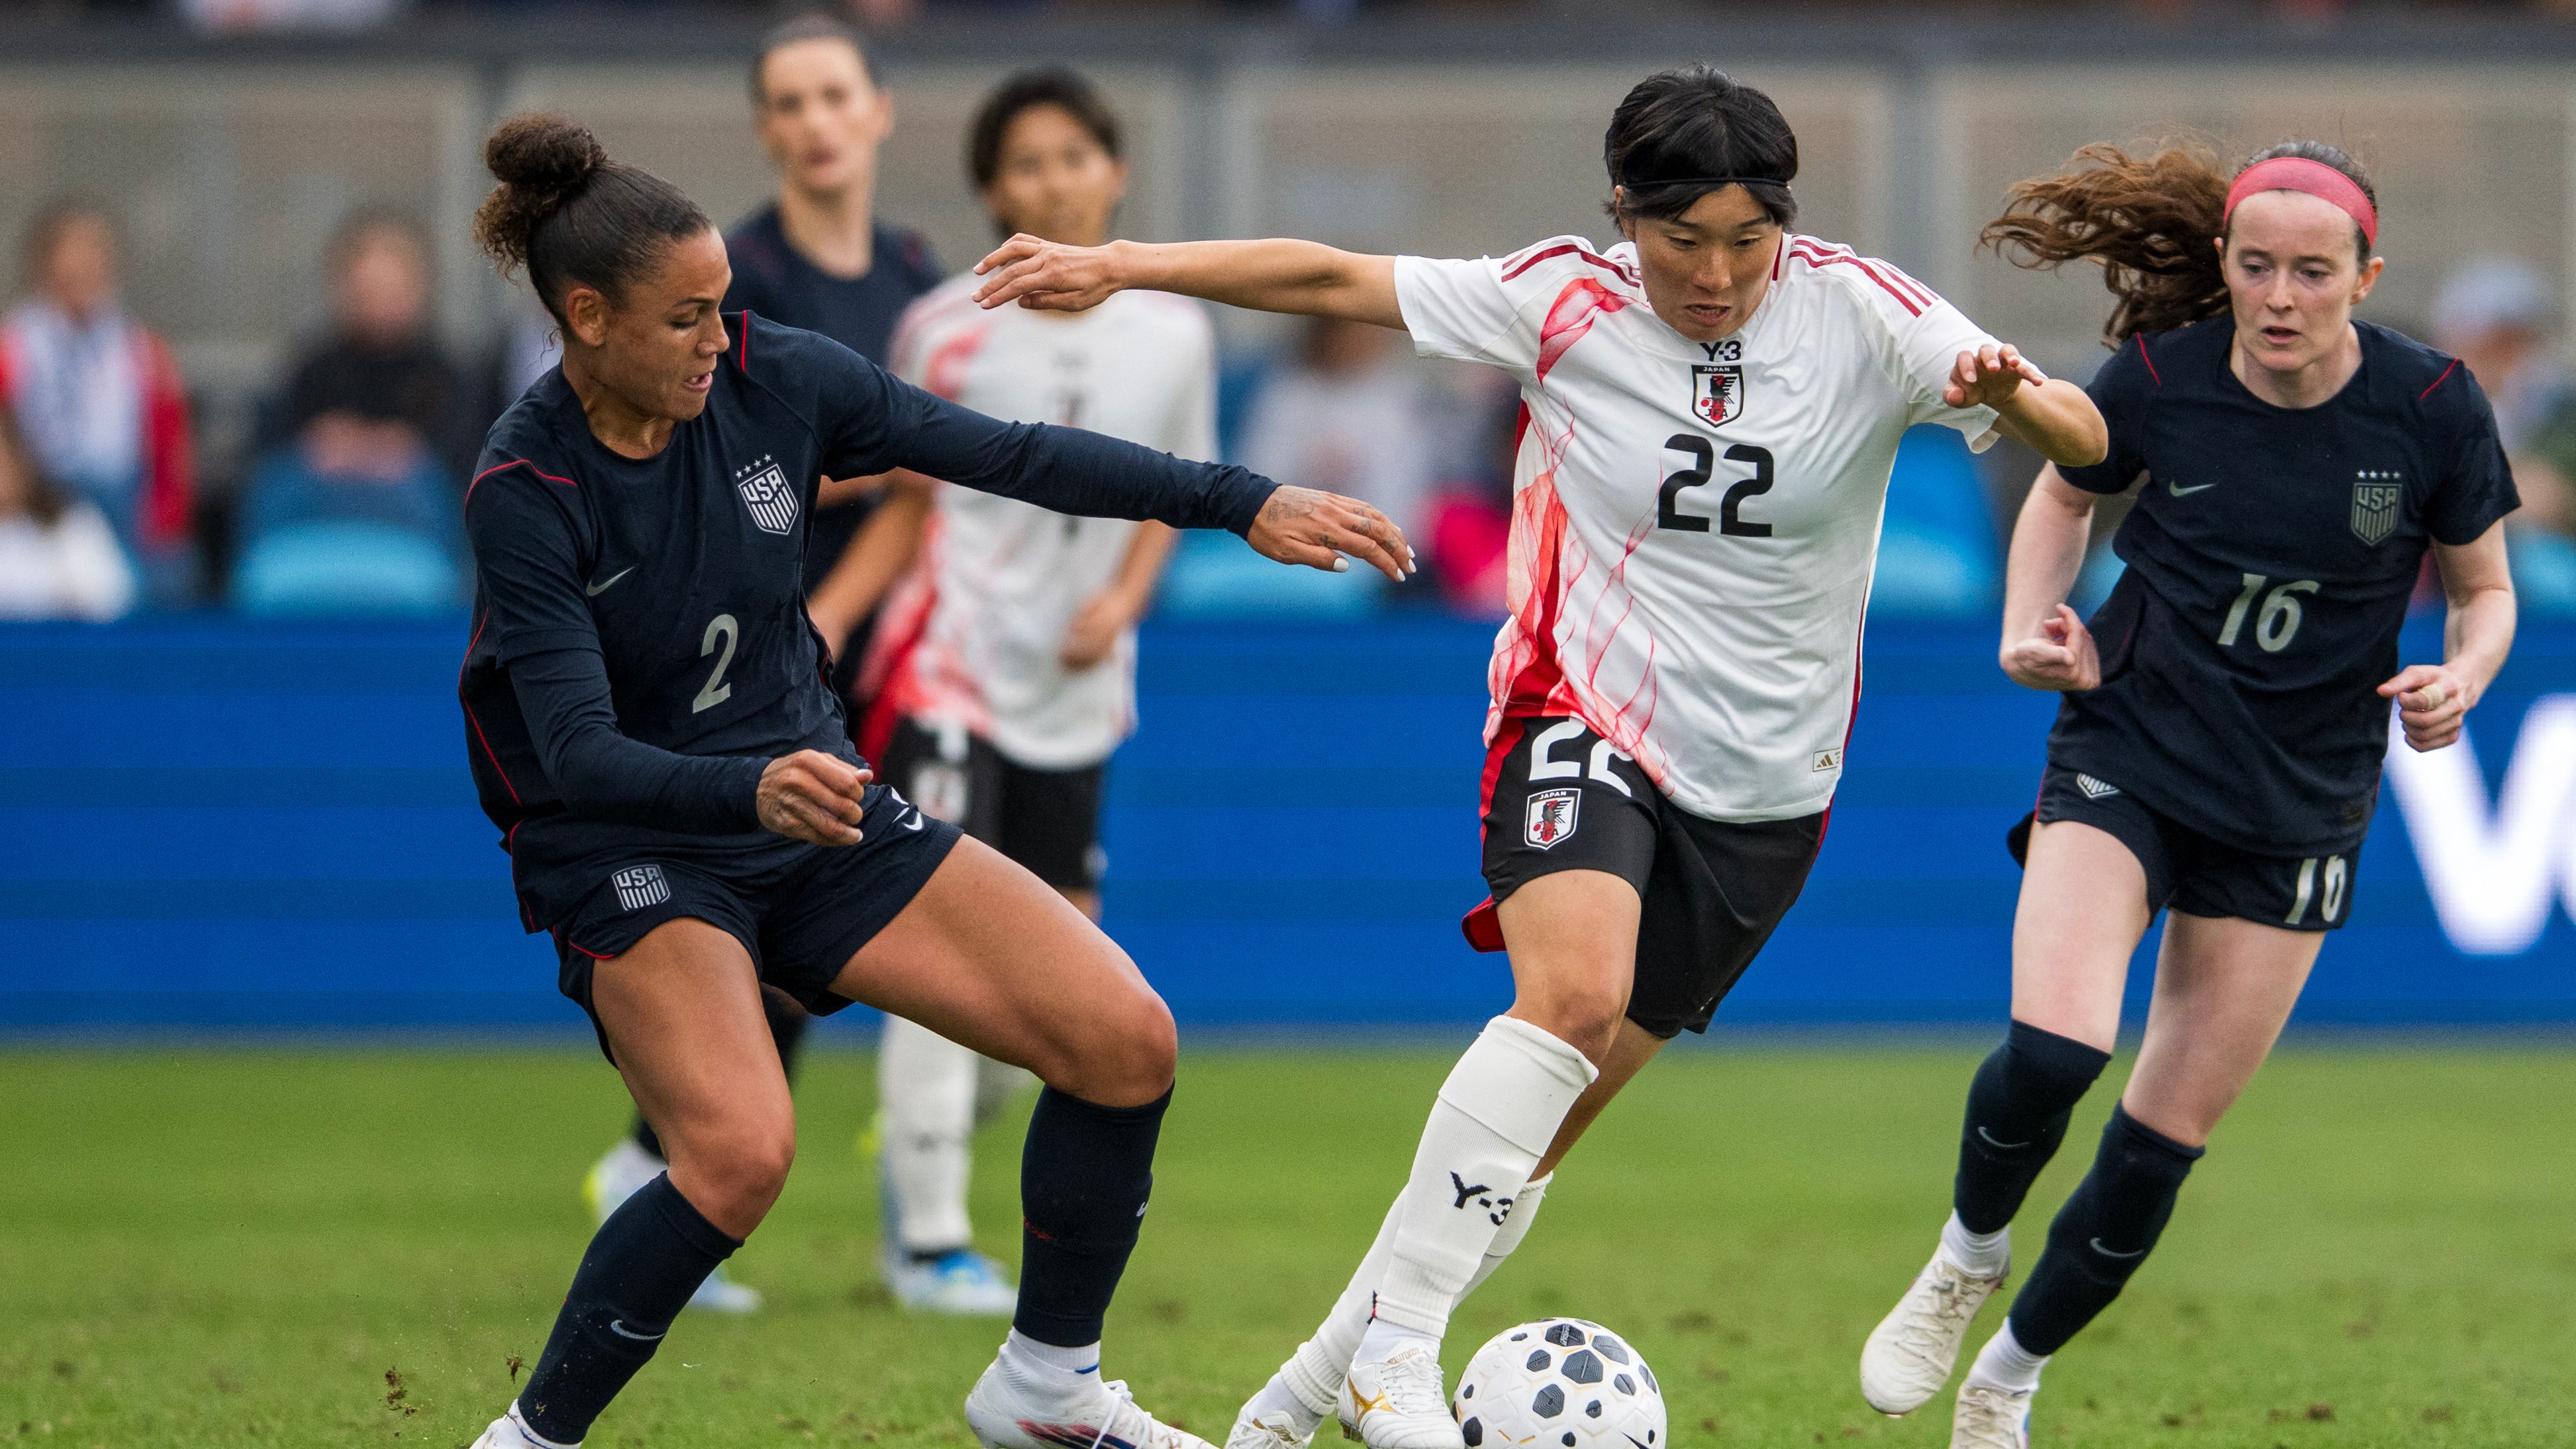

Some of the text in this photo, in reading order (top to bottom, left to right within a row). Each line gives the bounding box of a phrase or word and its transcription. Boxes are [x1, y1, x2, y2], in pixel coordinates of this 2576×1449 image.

[1699, 340, 1741, 362] Y-3
[743, 470, 782, 501] USA
[1658, 434, 1774, 537] 22
[2357, 487, 2397, 510] USA
[2217, 573, 2320, 652] 16
[693, 614, 738, 713] 2
[617, 868, 659, 887] USA
[1450, 1171, 1513, 1226] Y-3
